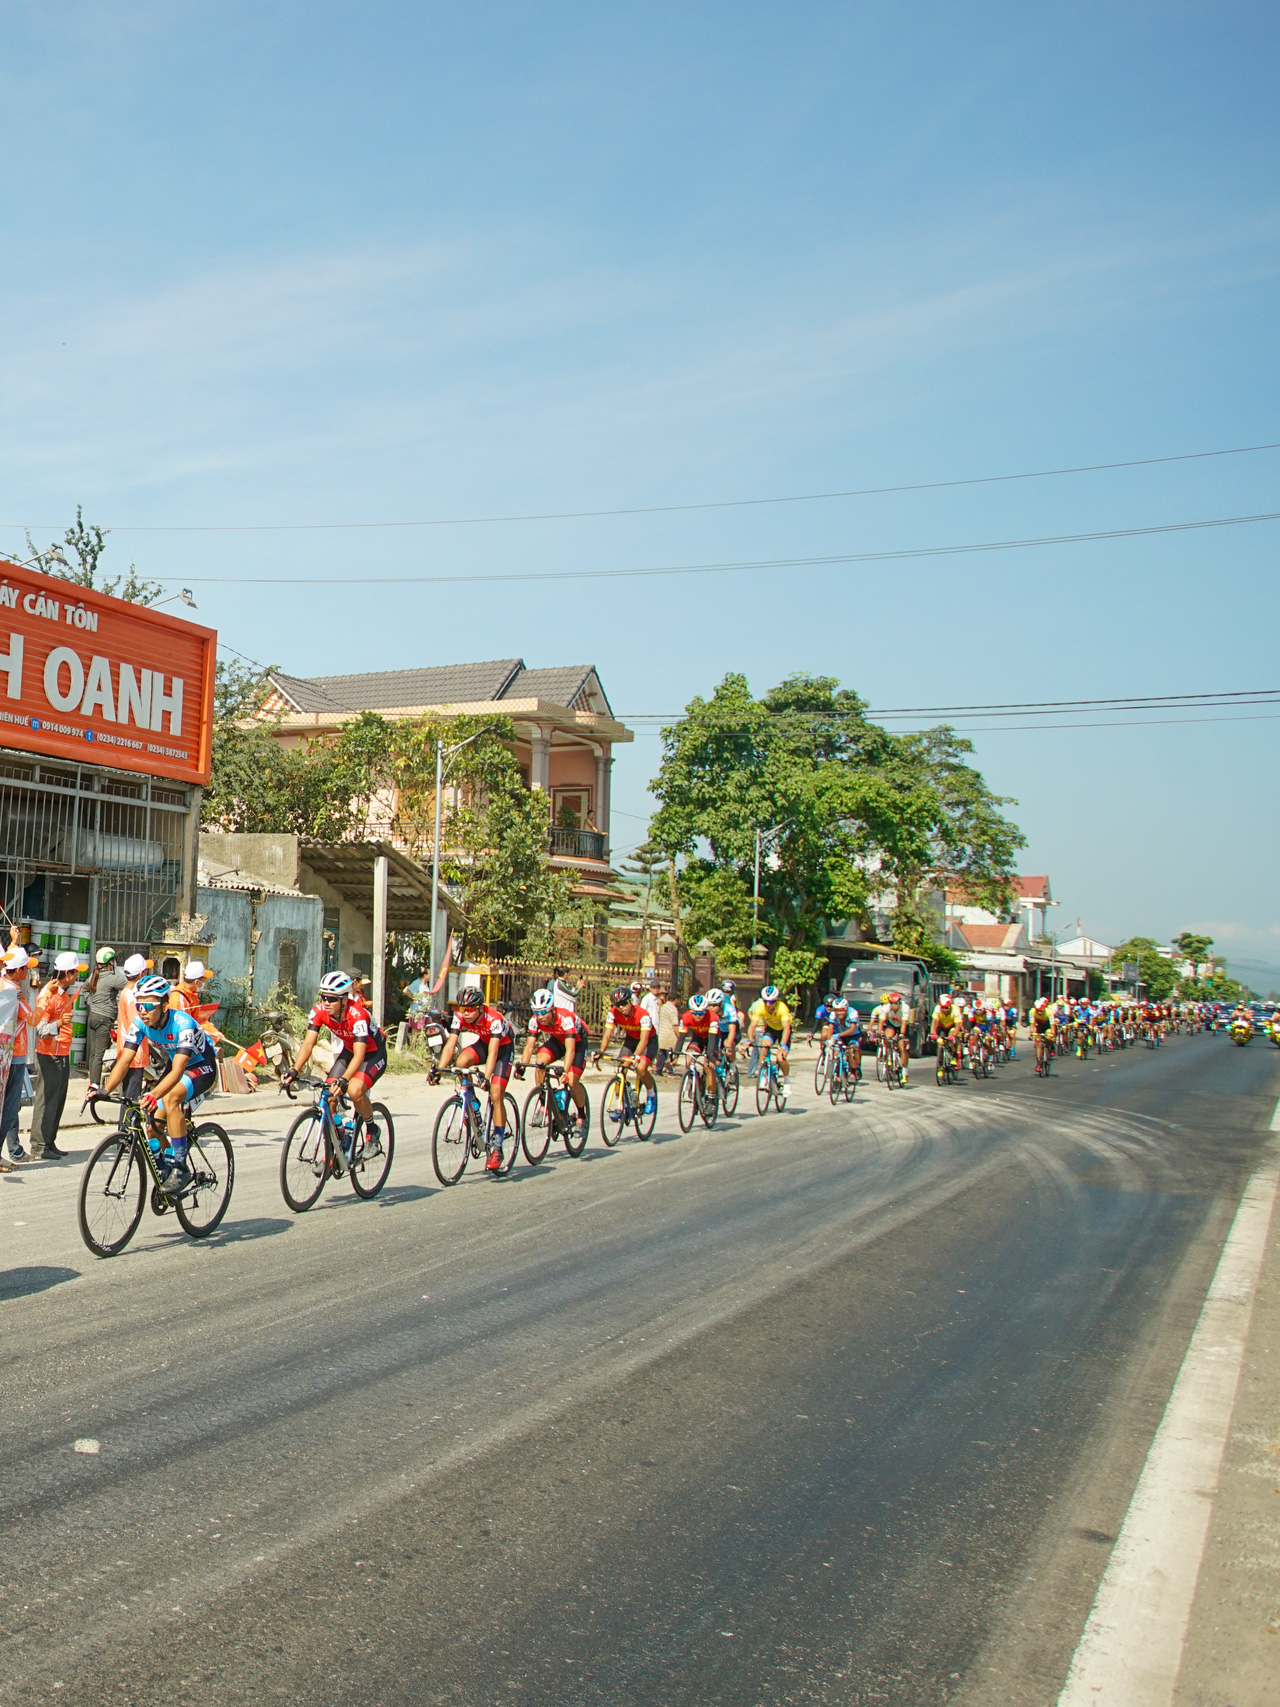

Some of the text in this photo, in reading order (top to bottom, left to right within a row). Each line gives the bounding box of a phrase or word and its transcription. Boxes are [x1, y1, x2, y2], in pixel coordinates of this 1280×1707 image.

[22, 590, 60, 621] CÁN
[64, 601, 99, 633] TÔN
[43, 646, 185, 737] OANH
[14, 714, 29, 726] HUẾ
[42, 721, 59, 732] 0914
[71, 728, 84, 738] 974
